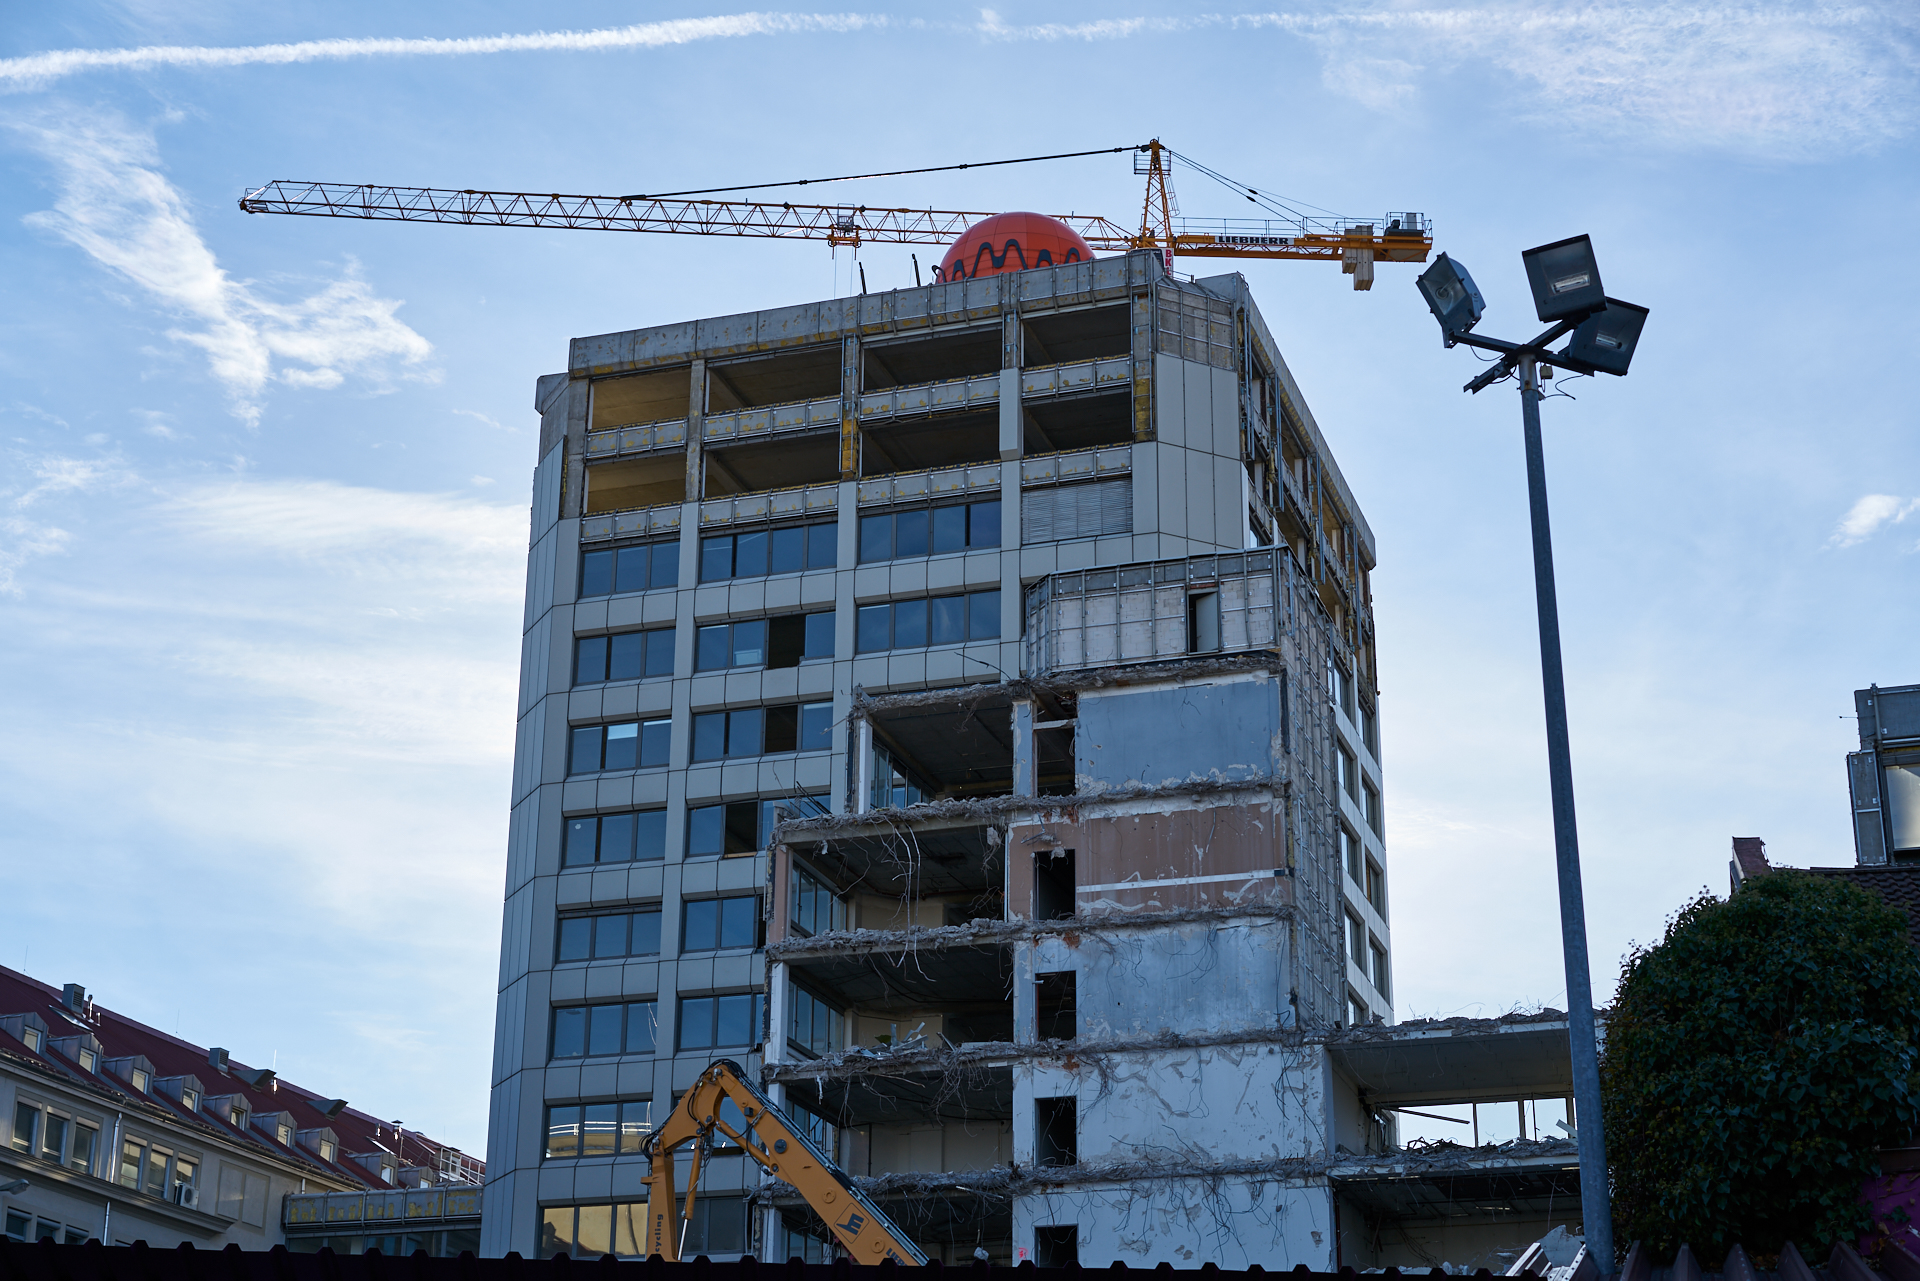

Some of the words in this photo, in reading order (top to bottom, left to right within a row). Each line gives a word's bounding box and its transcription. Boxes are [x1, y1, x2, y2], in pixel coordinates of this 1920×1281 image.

[1219, 236, 1288, 245] LIEBHERR
[655, 1214, 664, 1254] cycling
[885, 1247, 909, 1266] LIEB
